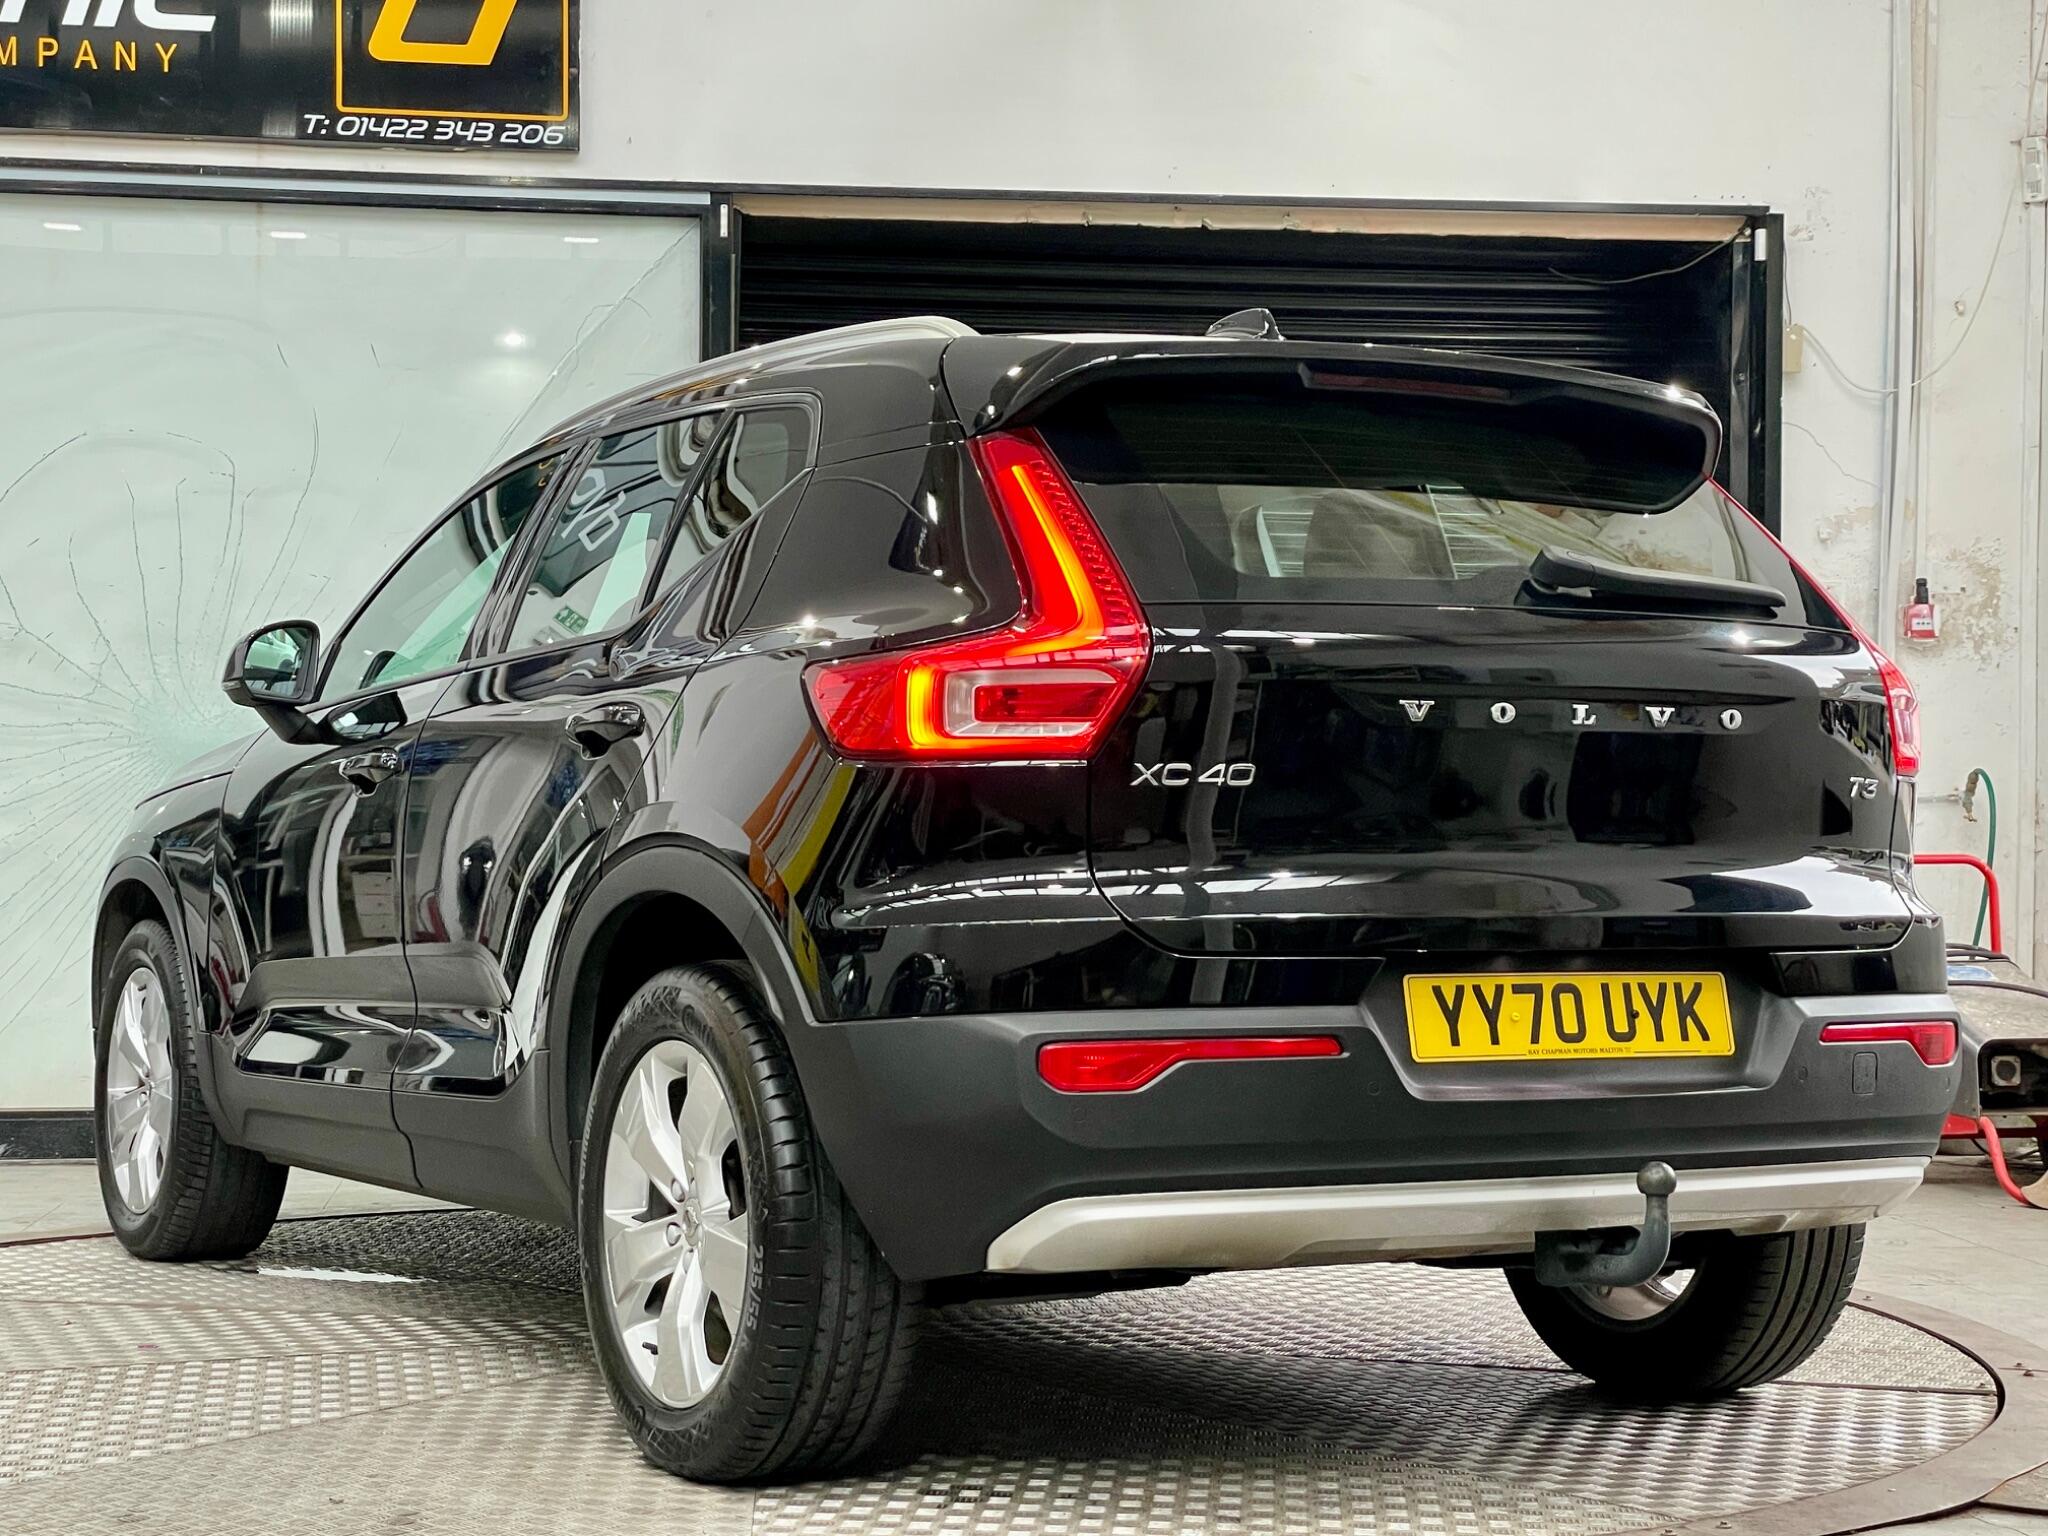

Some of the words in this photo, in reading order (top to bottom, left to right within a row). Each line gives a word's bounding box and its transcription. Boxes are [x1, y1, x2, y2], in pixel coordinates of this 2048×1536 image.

[303, 114, 330, 135] T:
[336, 117, 428, 140] 01422
[433, 120, 495, 142] 343
[500, 124, 566, 145] 206
[1399, 699, 1743, 731] VOLVO
[1850, 776, 1879, 799] T3
[1431, 982, 1587, 1047] YY70
[1601, 981, 1711, 1043] UYK
[746, 1244, 764, 1331] 235/55
